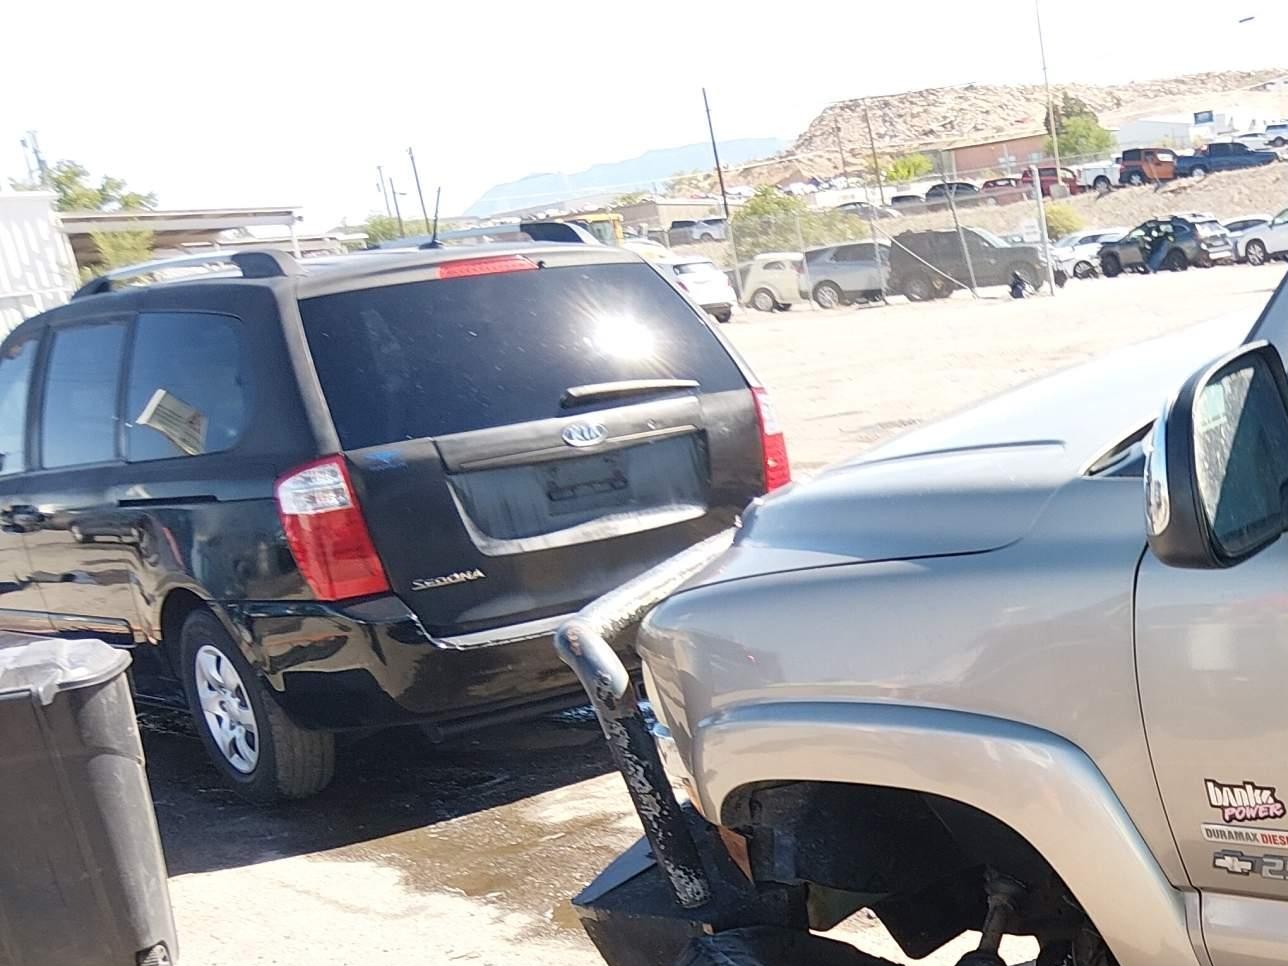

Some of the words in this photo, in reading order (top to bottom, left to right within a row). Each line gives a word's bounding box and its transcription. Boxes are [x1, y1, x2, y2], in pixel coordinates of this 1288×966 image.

[411, 568, 487, 591] SEDONA
[1223, 803, 1284, 822] POWER
[1204, 827, 1260, 843] DURAMAX
